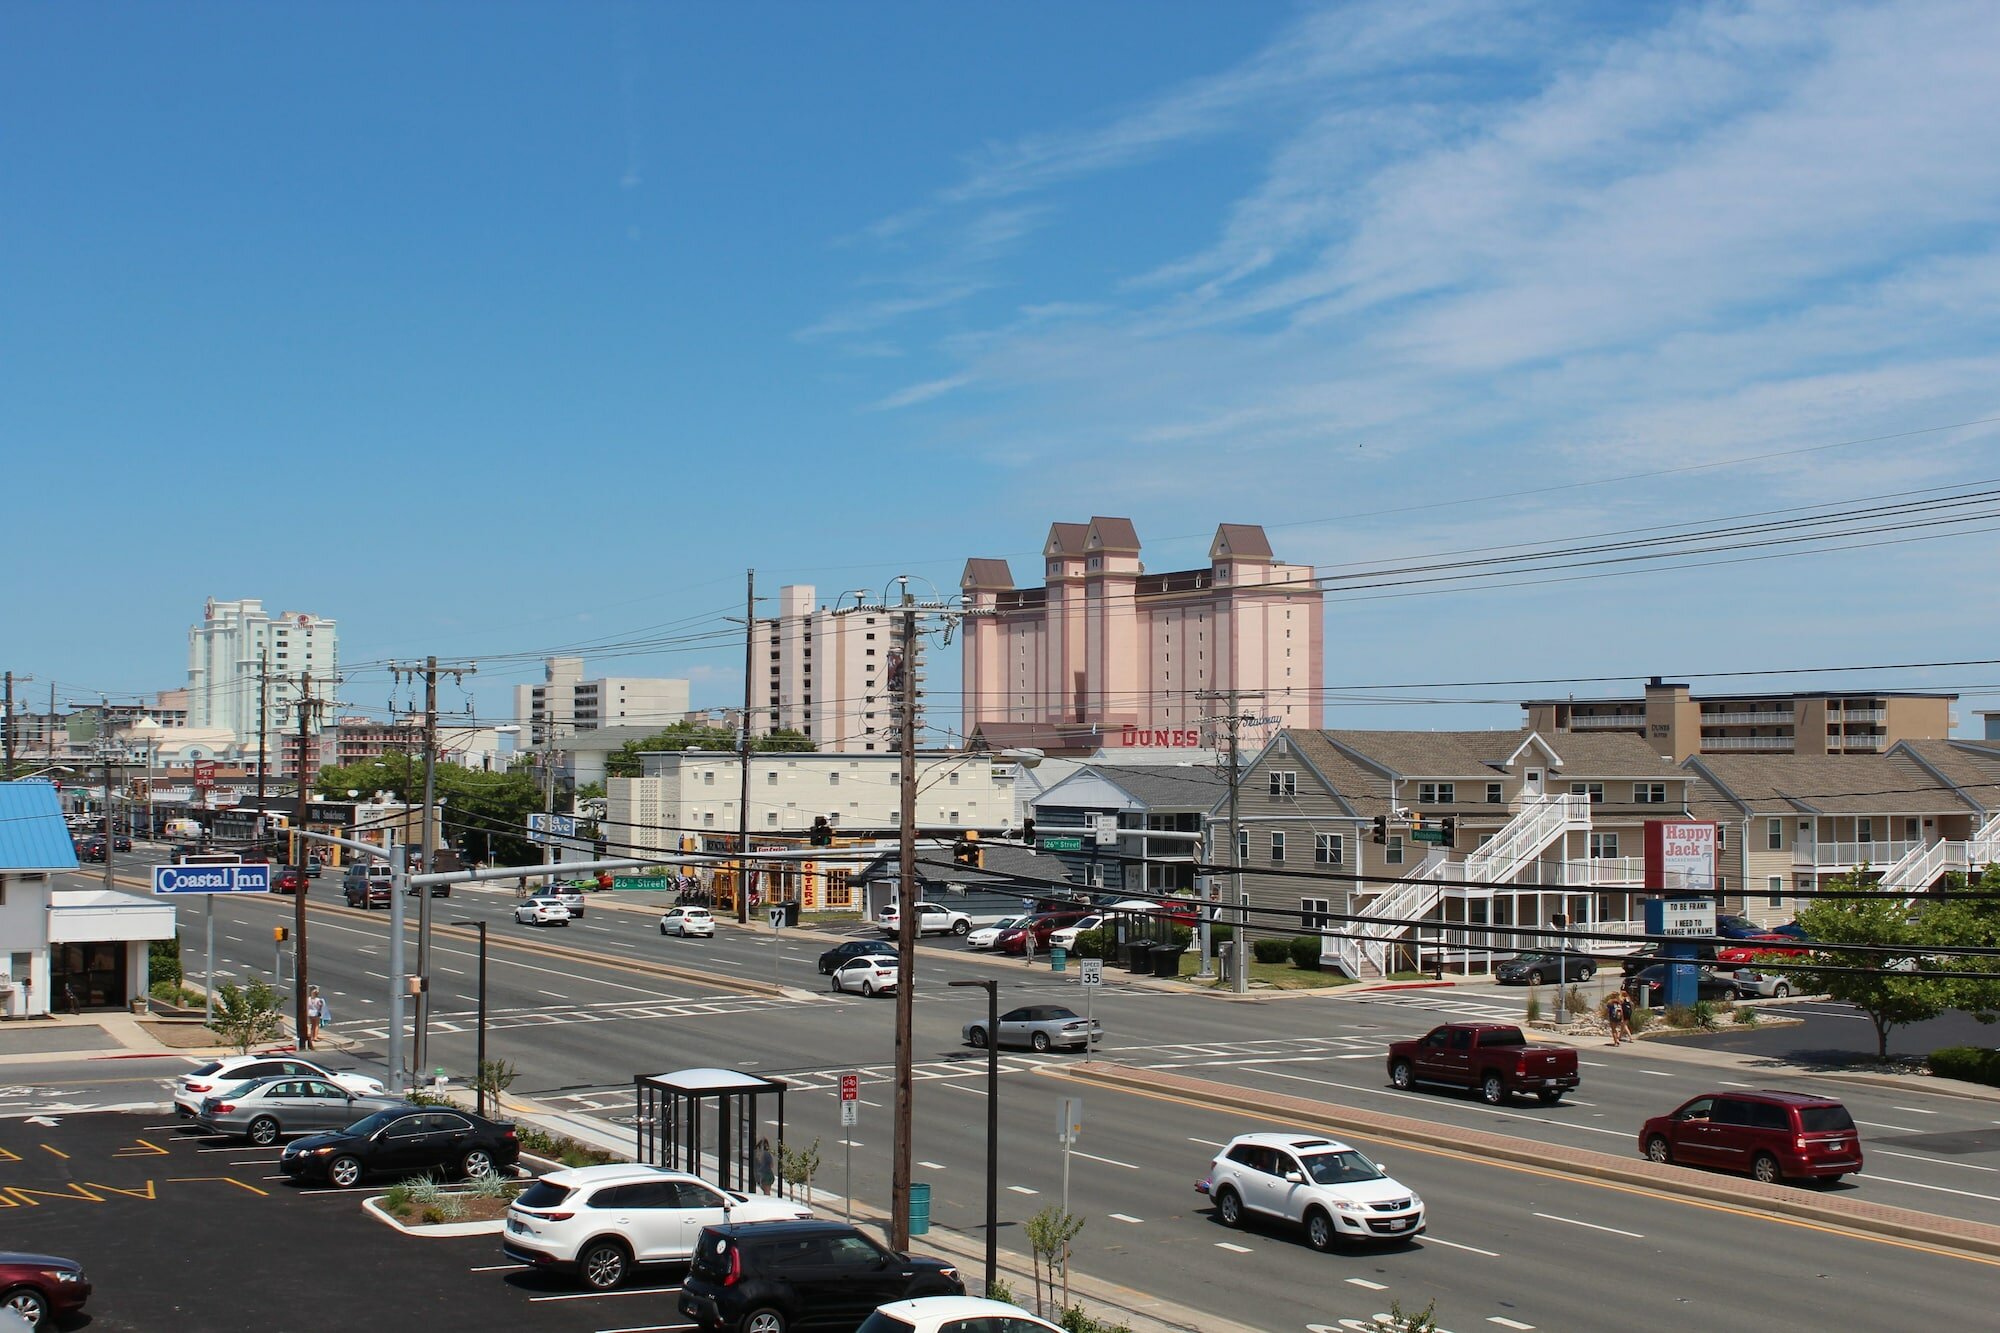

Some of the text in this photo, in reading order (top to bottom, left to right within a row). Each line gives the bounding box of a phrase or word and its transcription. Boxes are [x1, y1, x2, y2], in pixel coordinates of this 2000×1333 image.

[1122, 724, 1198, 747] DUNES
[198, 769, 213, 777] PIT
[1665, 825, 1713, 842] Happy
[1060, 841, 1080, 849] Street
[1665, 842, 1700, 857] Jack
[159, 867, 266, 892] Coastal Inn
[637, 877, 666, 888] Street
[1670, 903, 1678, 911] TO
[1689, 902, 1708, 910] FRANK
[1679, 919, 1693, 927] NEED
[1694, 919, 1702, 927] TO
[1663, 927, 1713, 936] CHANGE MY NAME
[1084, 973, 1100, 984] 35
